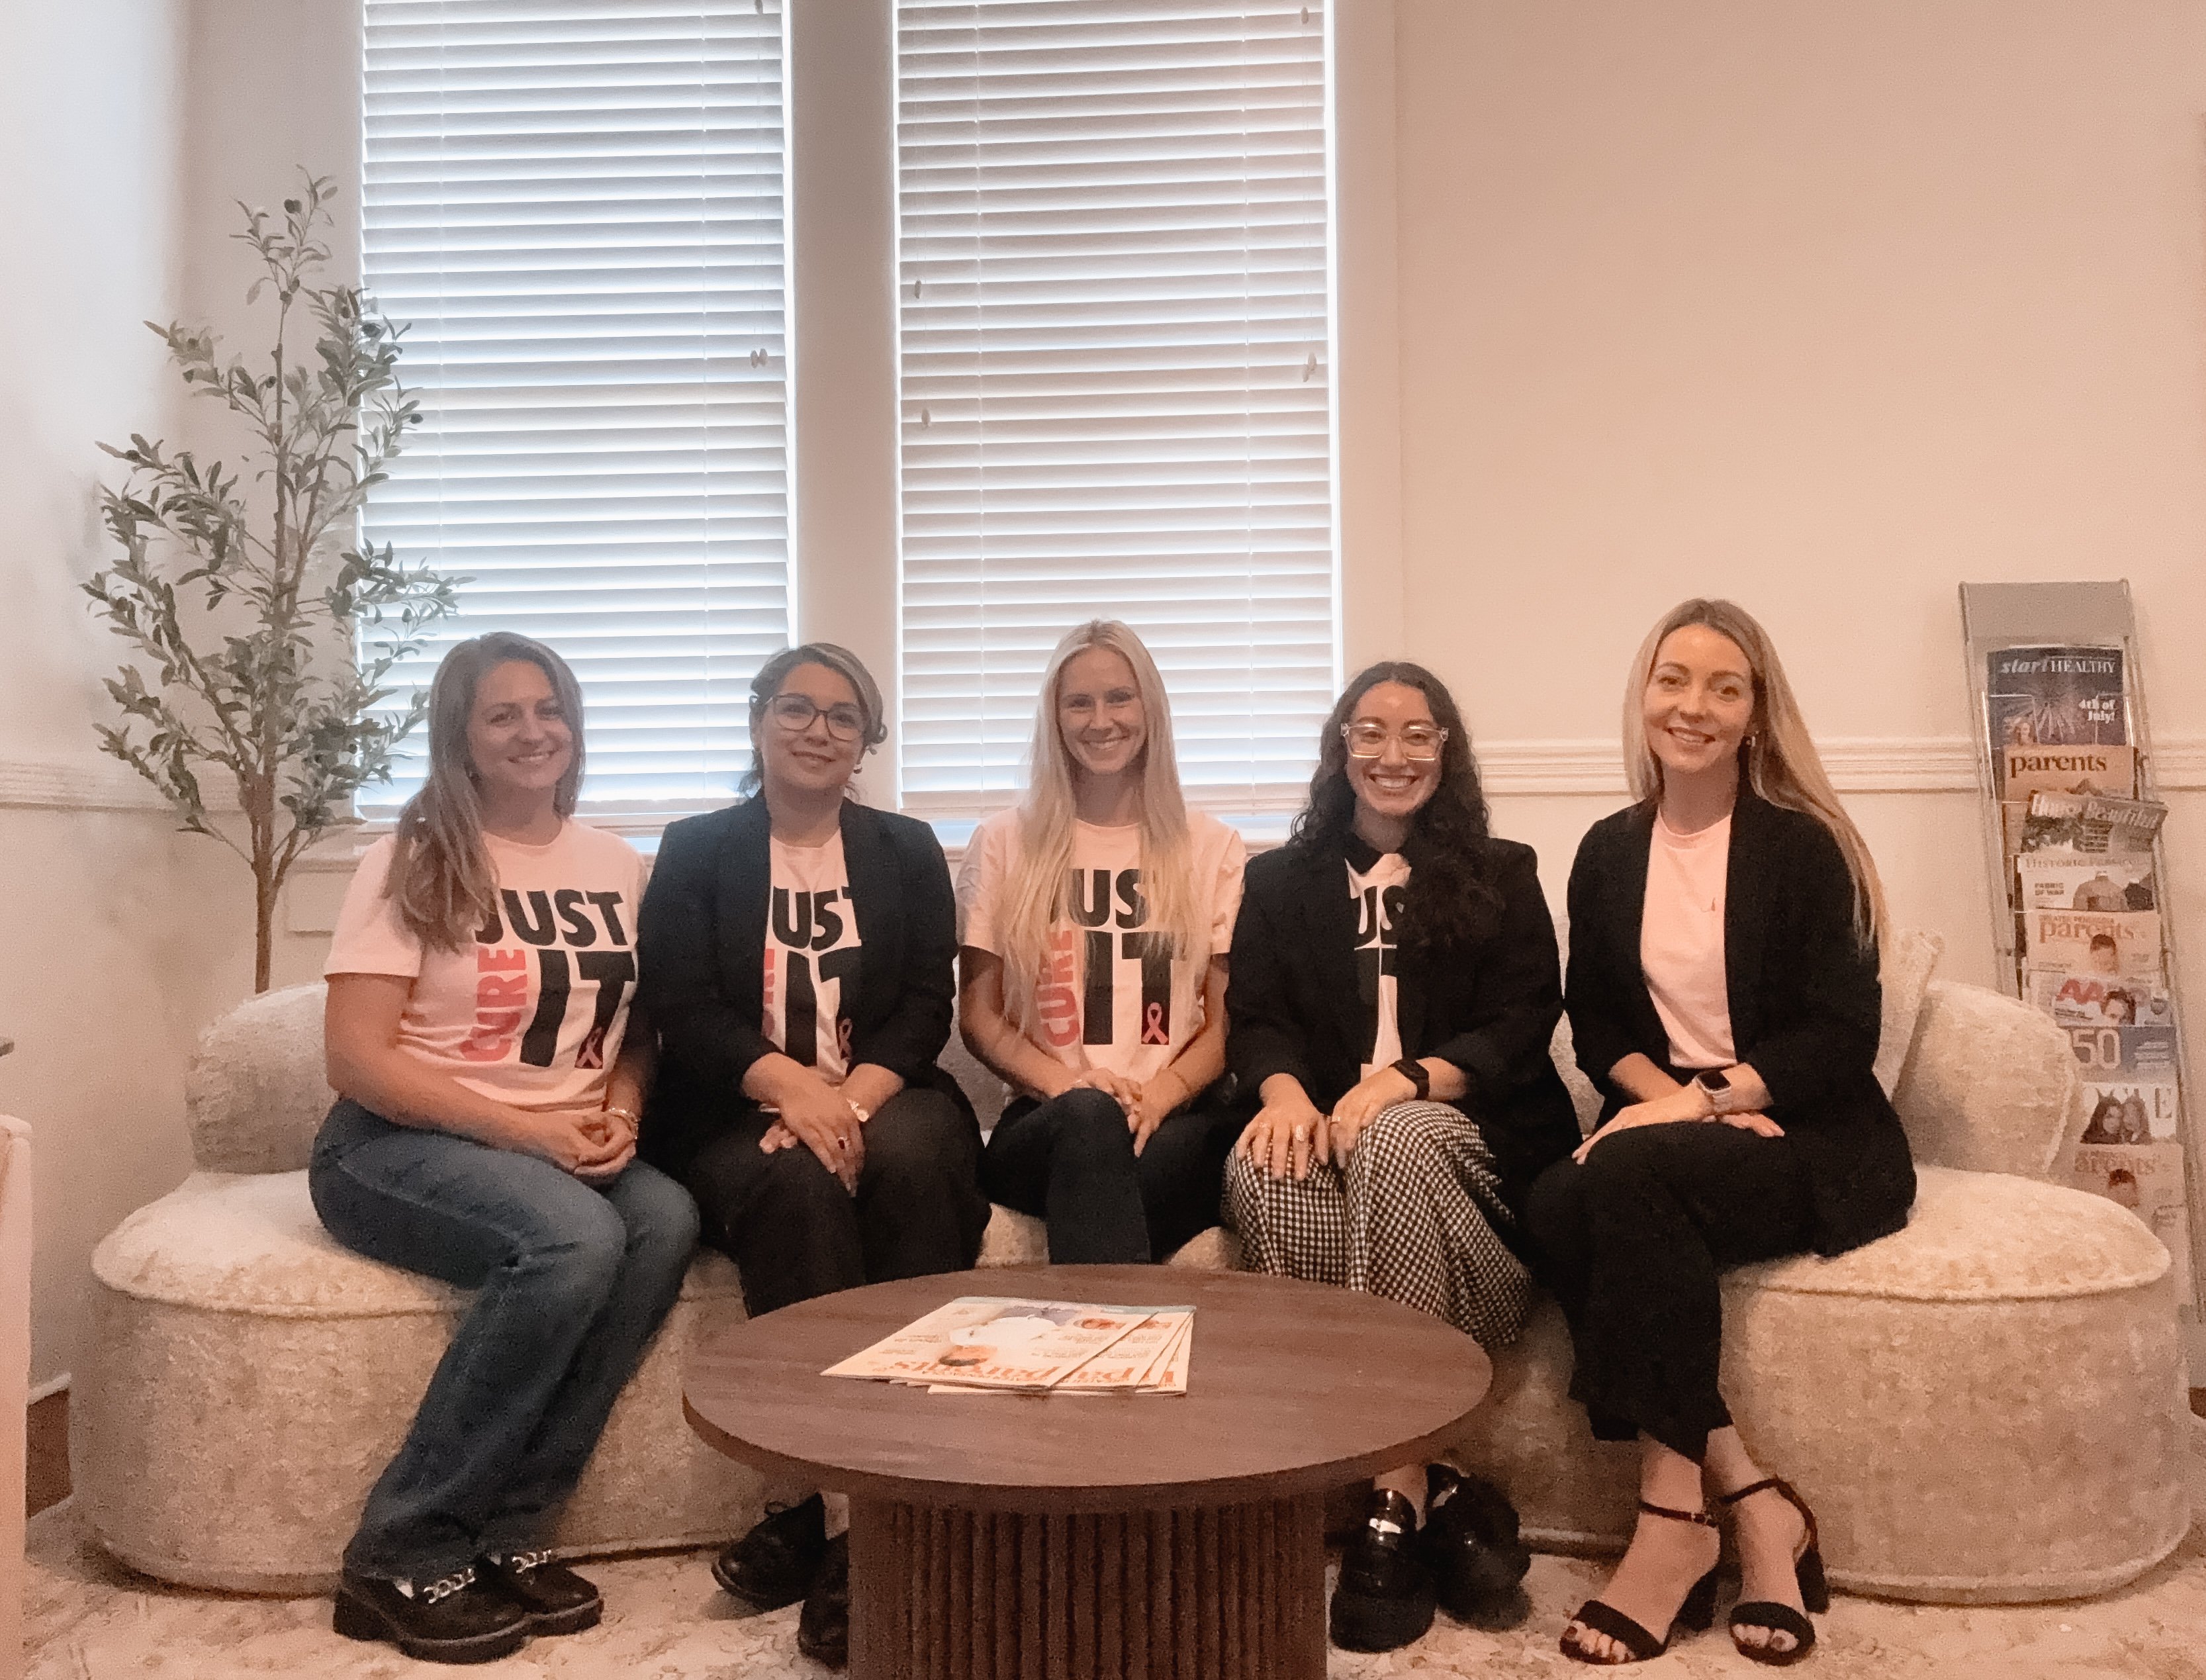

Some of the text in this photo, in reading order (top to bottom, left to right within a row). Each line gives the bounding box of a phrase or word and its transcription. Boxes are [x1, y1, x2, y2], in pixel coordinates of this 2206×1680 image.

[2050, 660, 2115, 674] HEALTHY
[2078, 698, 2116, 710] 4th of
[2010, 753, 2107, 778] parents
[772, 885, 849, 952] US
[1067, 868, 1151, 929] US
[458, 948, 528, 1062] CURE
[519, 949, 637, 1070] IT
[1082, 929, 1187, 1045] IT
[2072, 1027, 2121, 1070] 50
